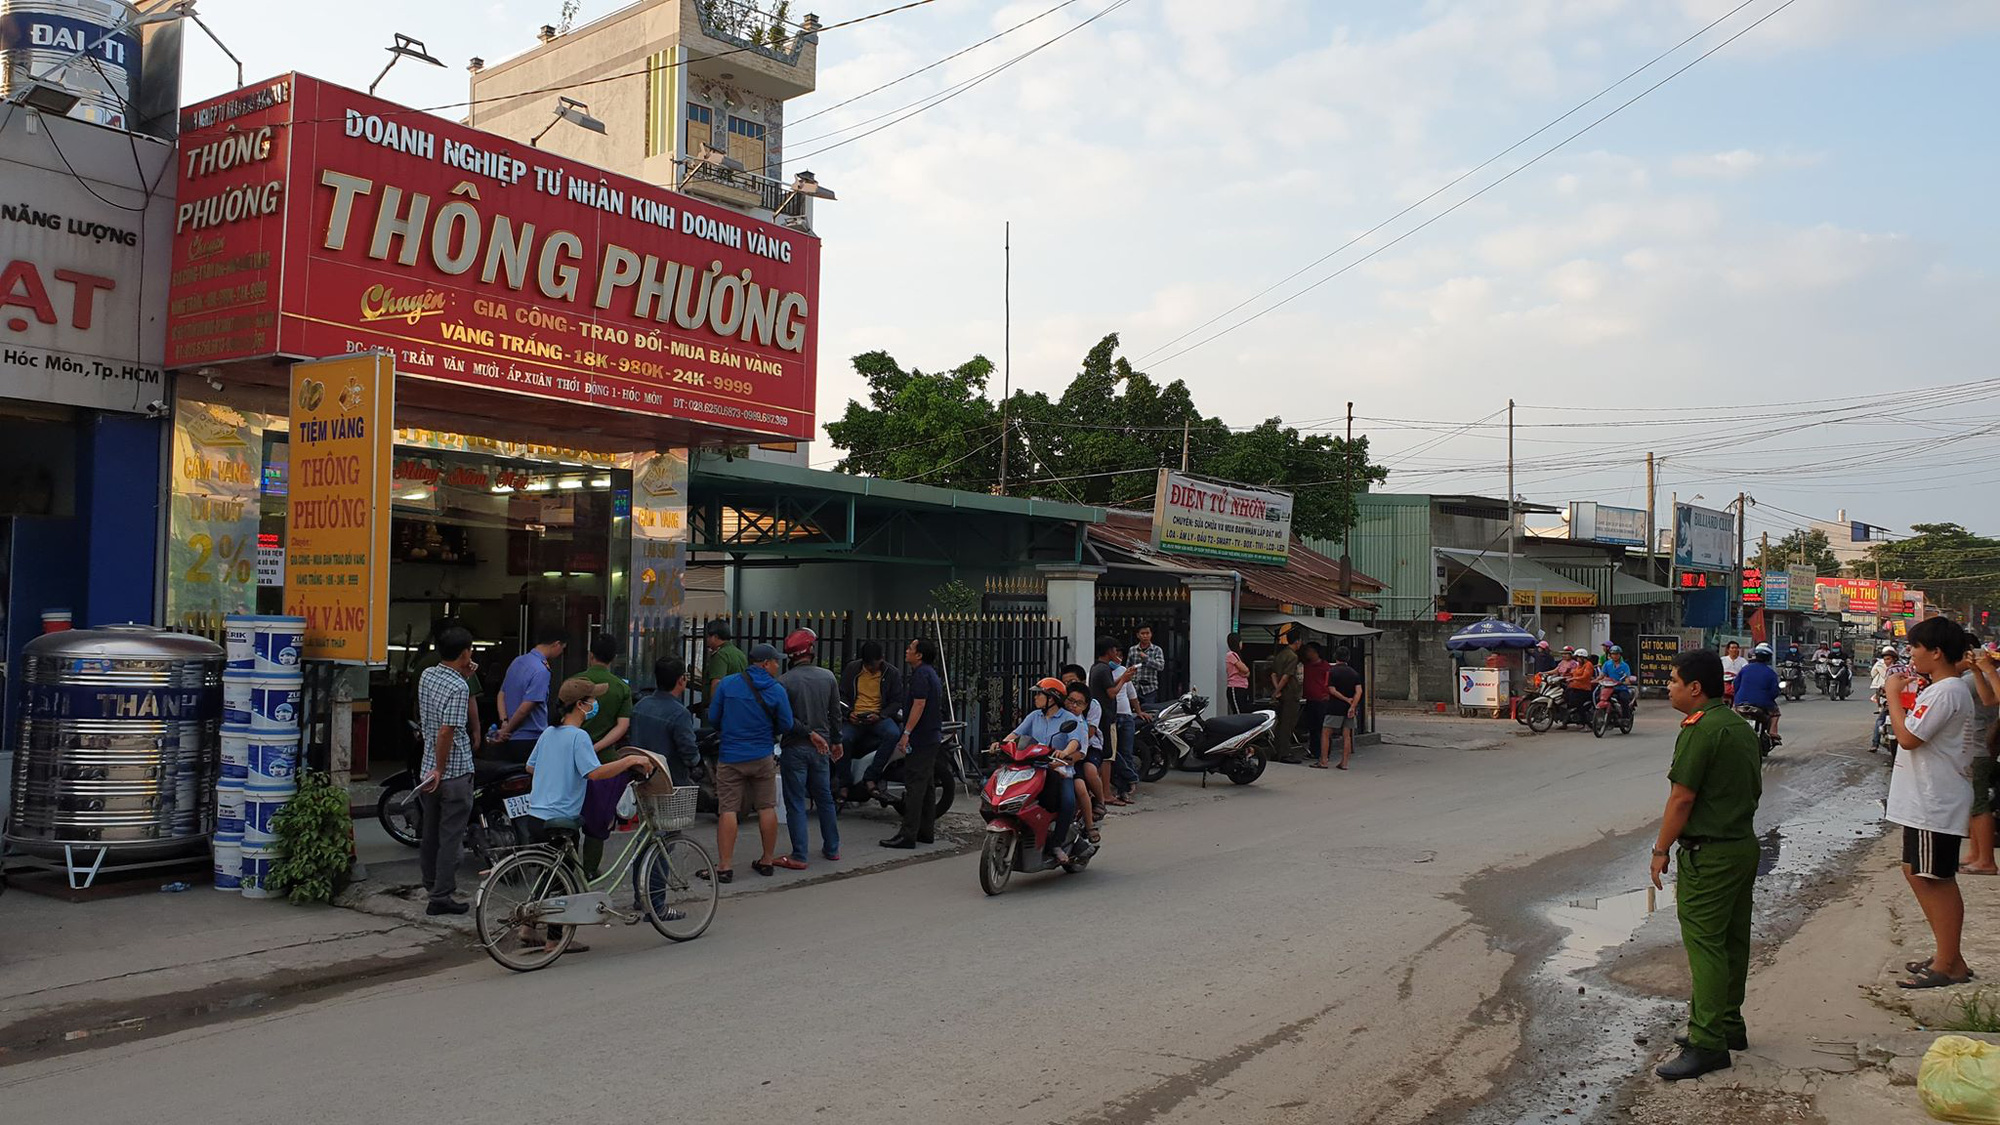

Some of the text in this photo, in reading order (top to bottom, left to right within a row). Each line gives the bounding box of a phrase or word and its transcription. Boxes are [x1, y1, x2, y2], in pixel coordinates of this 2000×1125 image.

[186, 124, 272, 179] THÔNG
[176, 180, 281, 235] PHƯƠNG
[345, 107, 792, 264] DOANH NGHIỆP TƯ NHÂN KINH DOANH VÀNG
[1, 203, 137, 247] NĂNG LƯỢNG
[321, 168, 808, 354] THÔNG PHƯƠNG
[4, 349, 39, 367] Hóc
[440, 319, 494, 347] VÀNG
[499, 332, 563, 360] TRẮNG
[713, 375, 753, 395] 9999
[473, 299, 508, 320] GIA
[515, 306, 568, 333] CÔNG
[578, 321, 629, 345] TRAO
[634, 328, 663, 352] ĐỔI
[671, 341, 706, 362] MUA
[710, 347, 741, 369] BÁN
[744, 353, 783, 377] VÀNG
[401, 348, 435, 367] TRẦN
[443, 356, 465, 373] VĂN
[643, 392, 663, 406] MÔN
[300, 413, 365, 447] TIỆM VÀNG
[184, 452, 251, 484] CẦM VÀNG
[301, 450, 360, 488] THÔNG
[293, 493, 366, 530] PHƯƠNG
[1170, 483, 1207, 512] ĐIỆN
[1209, 488, 1228, 513] TỬ
[1694, 512, 1718, 529] BILLIARD
[185, 532, 251, 584] 2%
[322, 599, 365, 632] VÀNG
